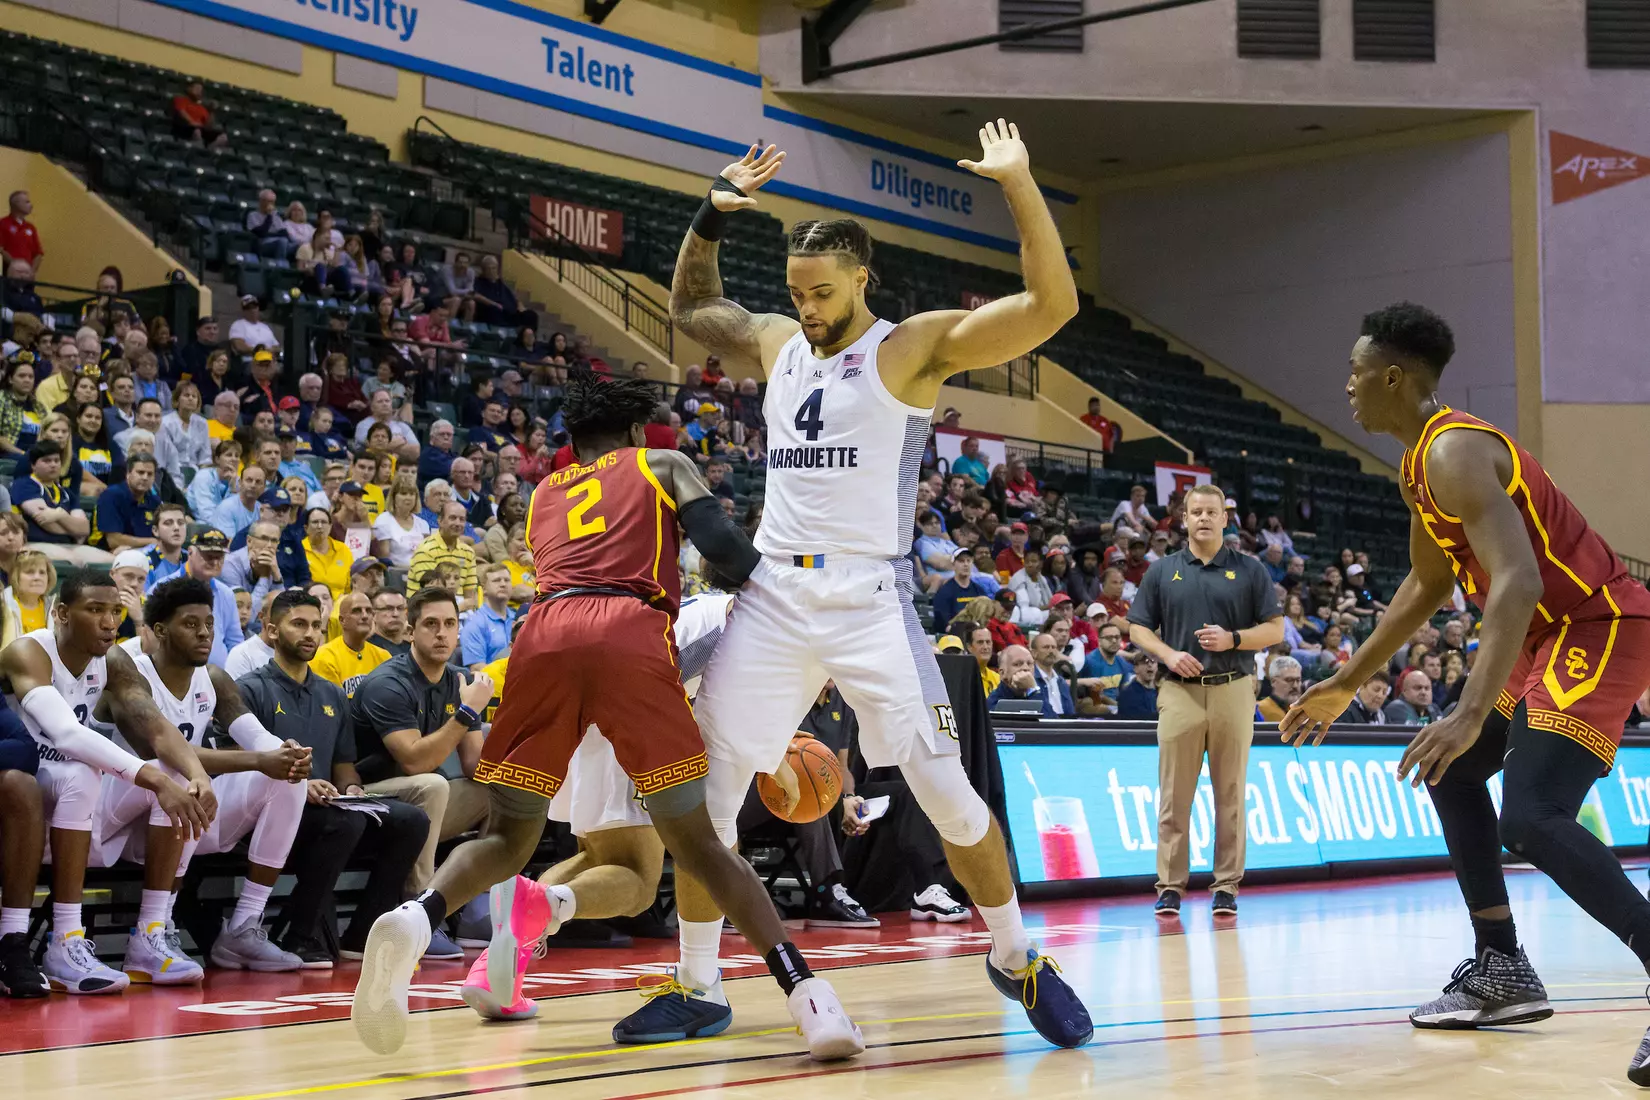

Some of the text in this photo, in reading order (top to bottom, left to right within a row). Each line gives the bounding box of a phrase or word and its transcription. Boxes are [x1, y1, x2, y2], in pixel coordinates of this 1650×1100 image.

[294, 0, 418, 42] nsity
[541, 37, 635, 97] Talent
[871, 159, 973, 215] Diligence
[1554, 153, 1637, 184] APEX
[546, 201, 609, 250] HOME
[813, 370, 823, 378] AL
[794, 388, 825, 441] 4
[769, 447, 858, 469] MARQUETTE
[565, 477, 607, 540] 2
[1107, 761, 1292, 867] trpial
[1285, 759, 1446, 844] SMOOTH
